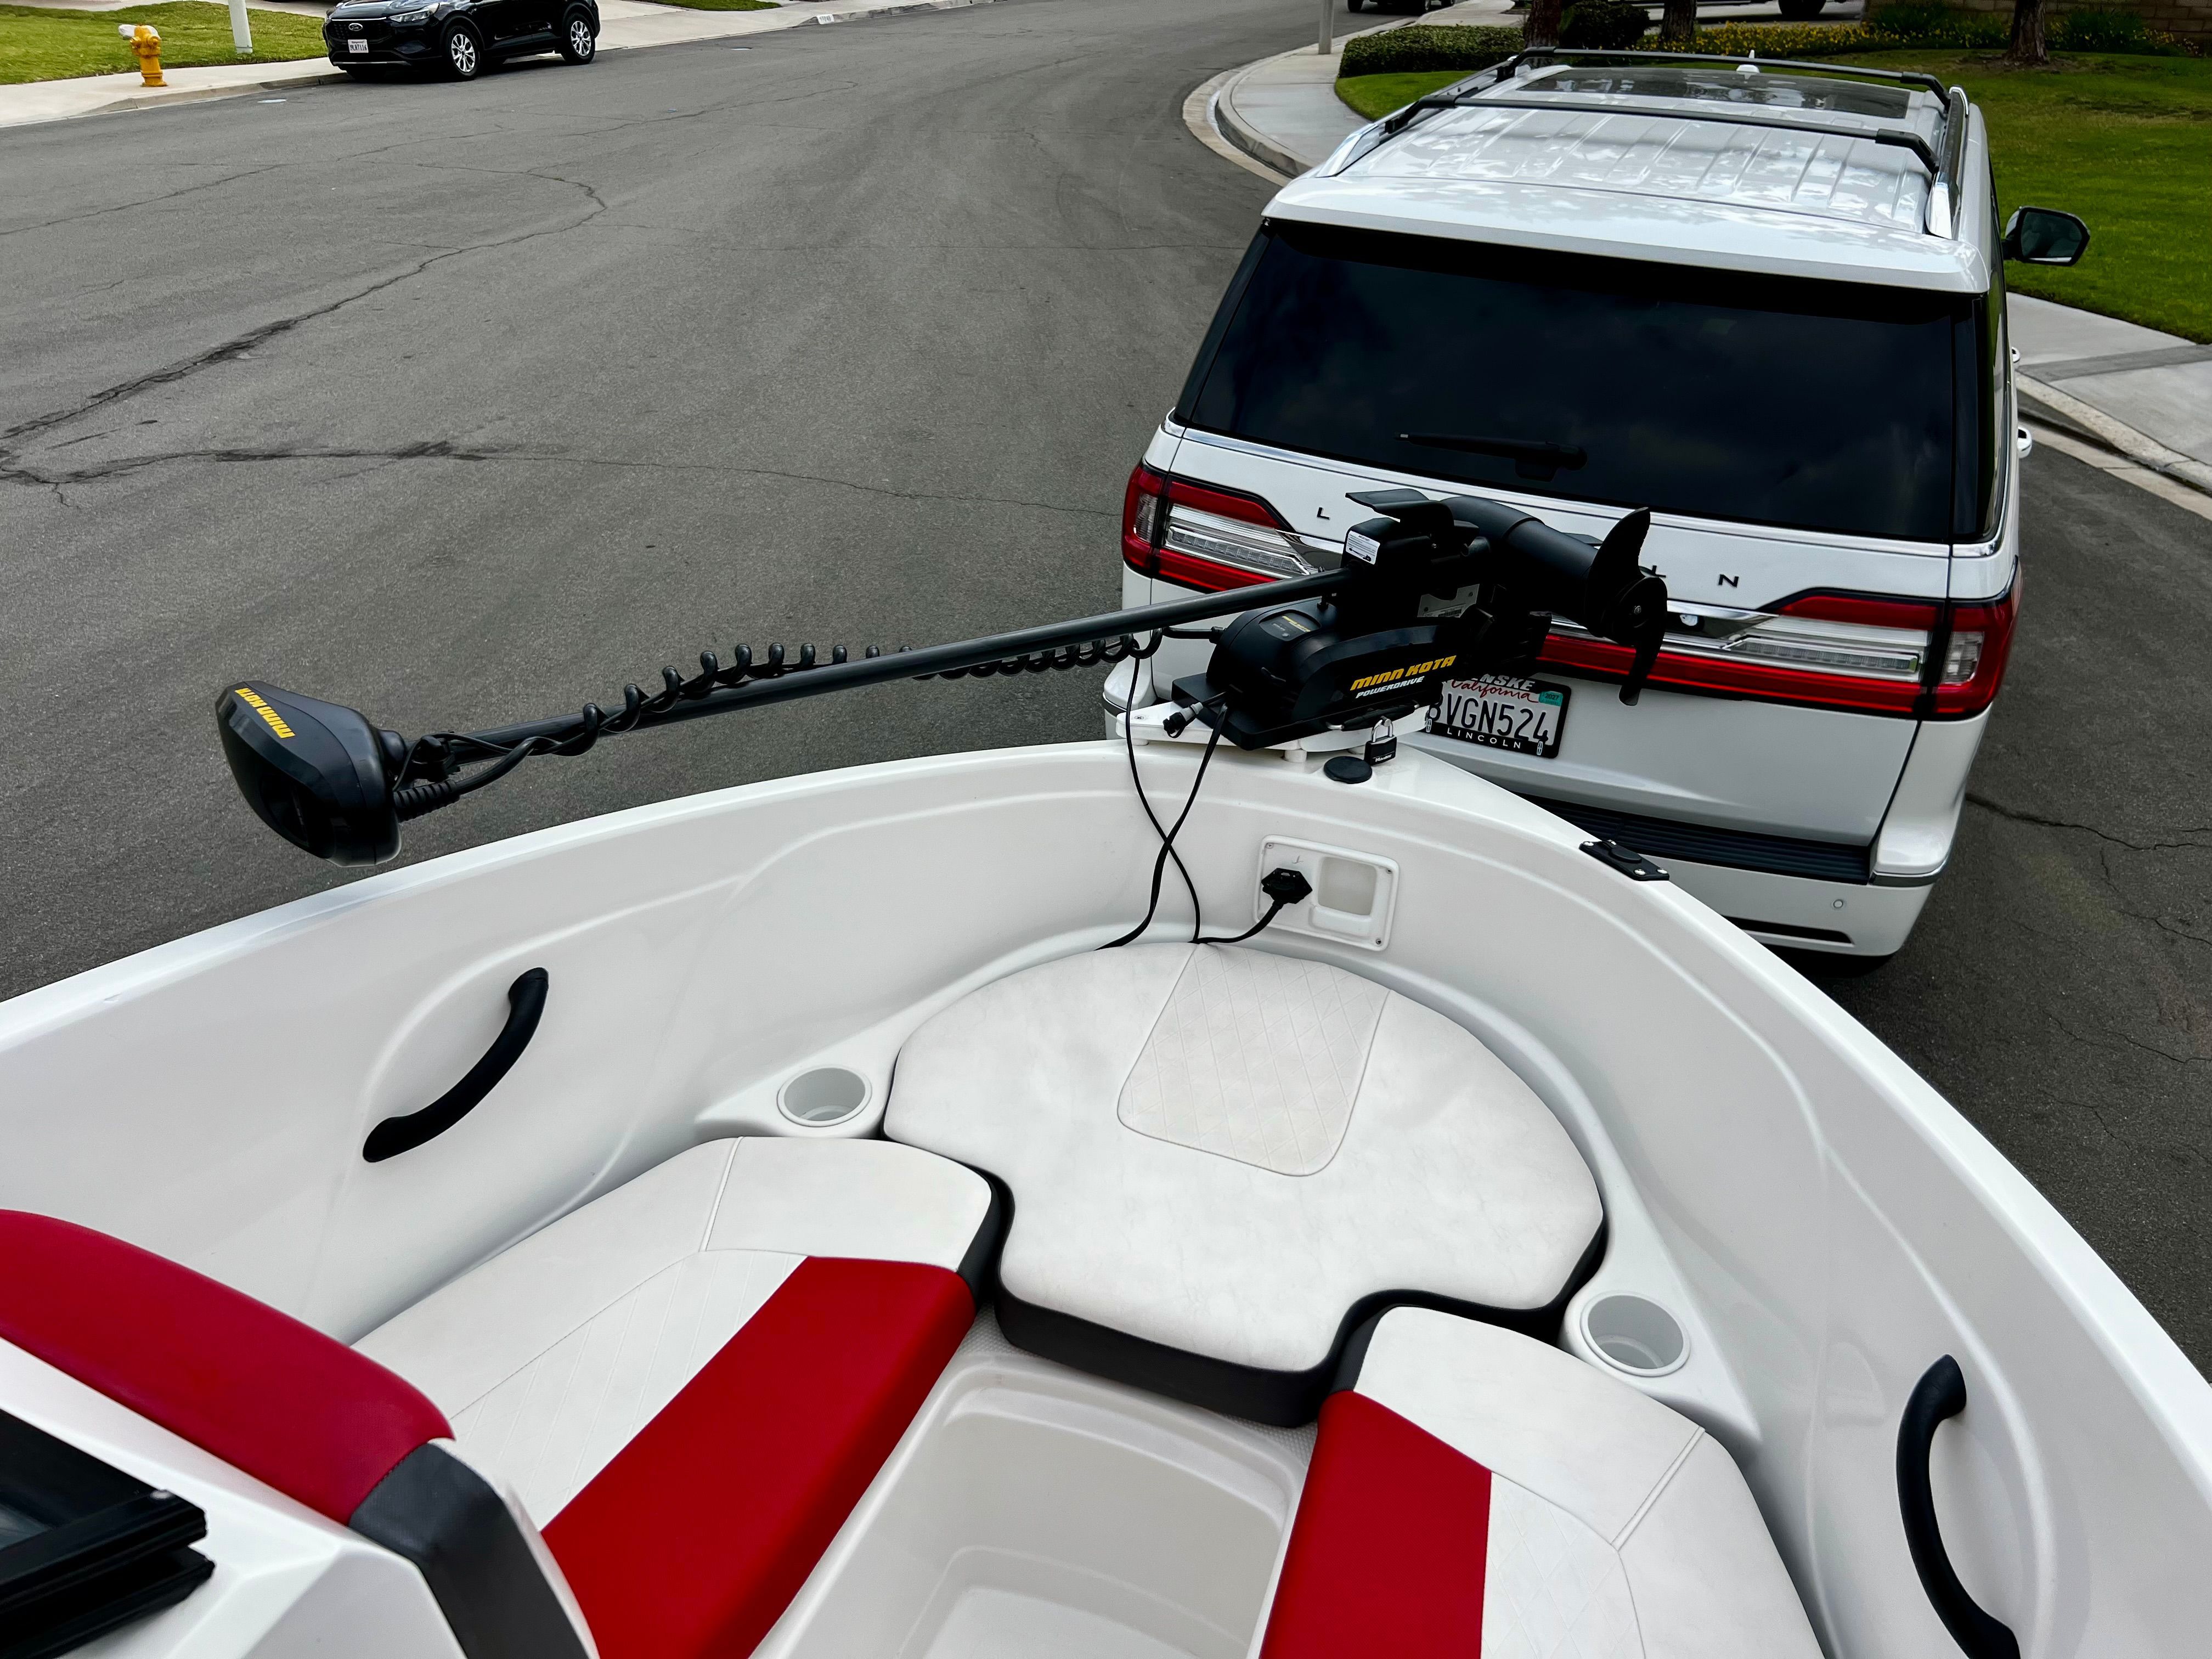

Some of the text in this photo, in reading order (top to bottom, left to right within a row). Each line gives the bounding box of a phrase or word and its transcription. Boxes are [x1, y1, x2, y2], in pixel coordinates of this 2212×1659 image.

[1405, 656, 1457, 677] KOTA
[1355, 676, 1425, 698] POWERDRIVE
[1471, 674, 1535, 691] NSKE
[234, 687, 268, 708] KOTA
[1447, 727, 1521, 749] LINCOLN
